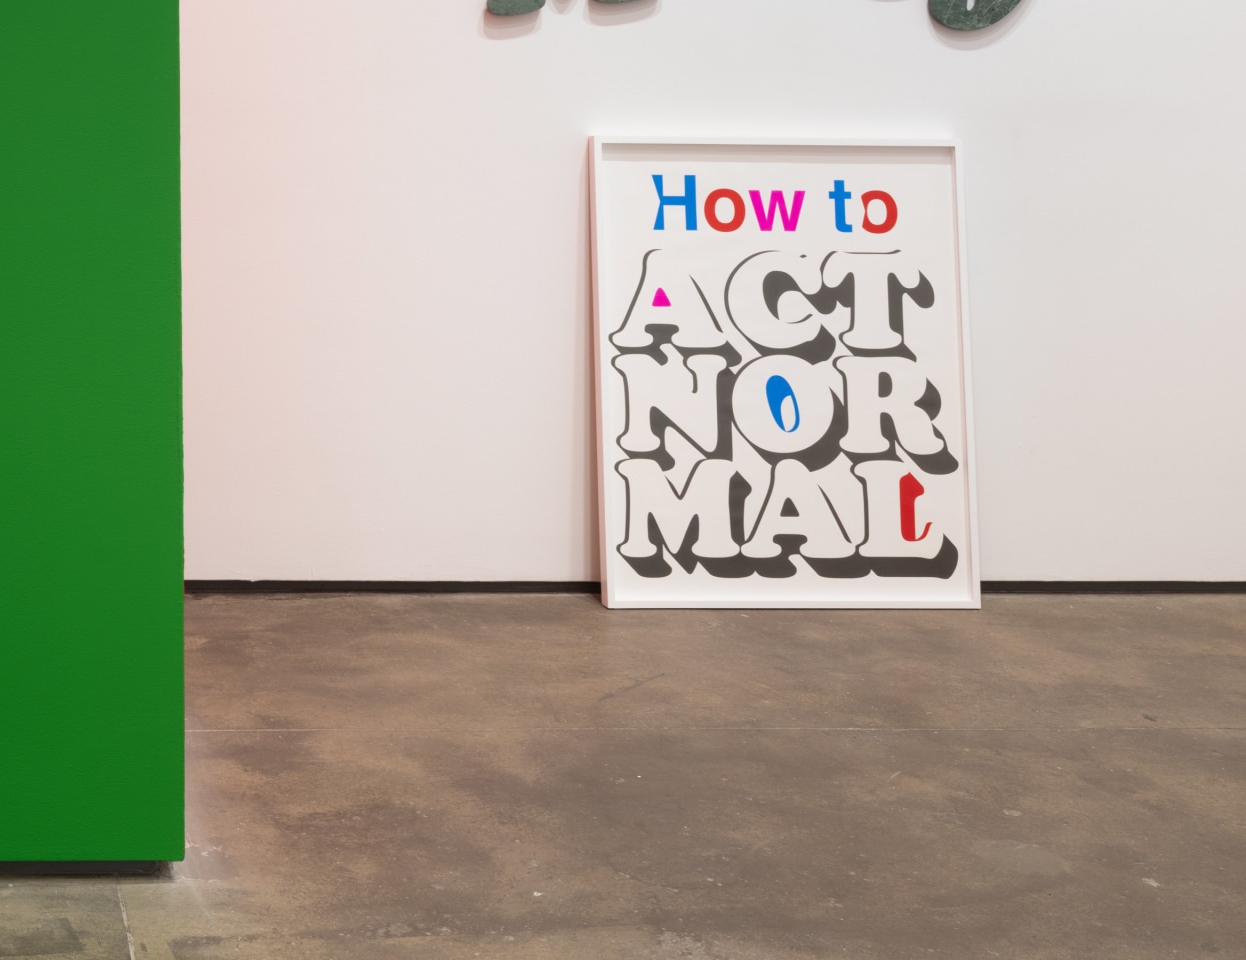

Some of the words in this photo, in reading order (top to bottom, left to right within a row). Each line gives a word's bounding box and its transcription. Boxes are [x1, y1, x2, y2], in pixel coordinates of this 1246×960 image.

[651, 174, 806, 233] How
[828, 179, 899, 234] to
[608, 248, 935, 367] ACT
[611, 353, 960, 476] NOR
[614, 457, 959, 579] MAL
